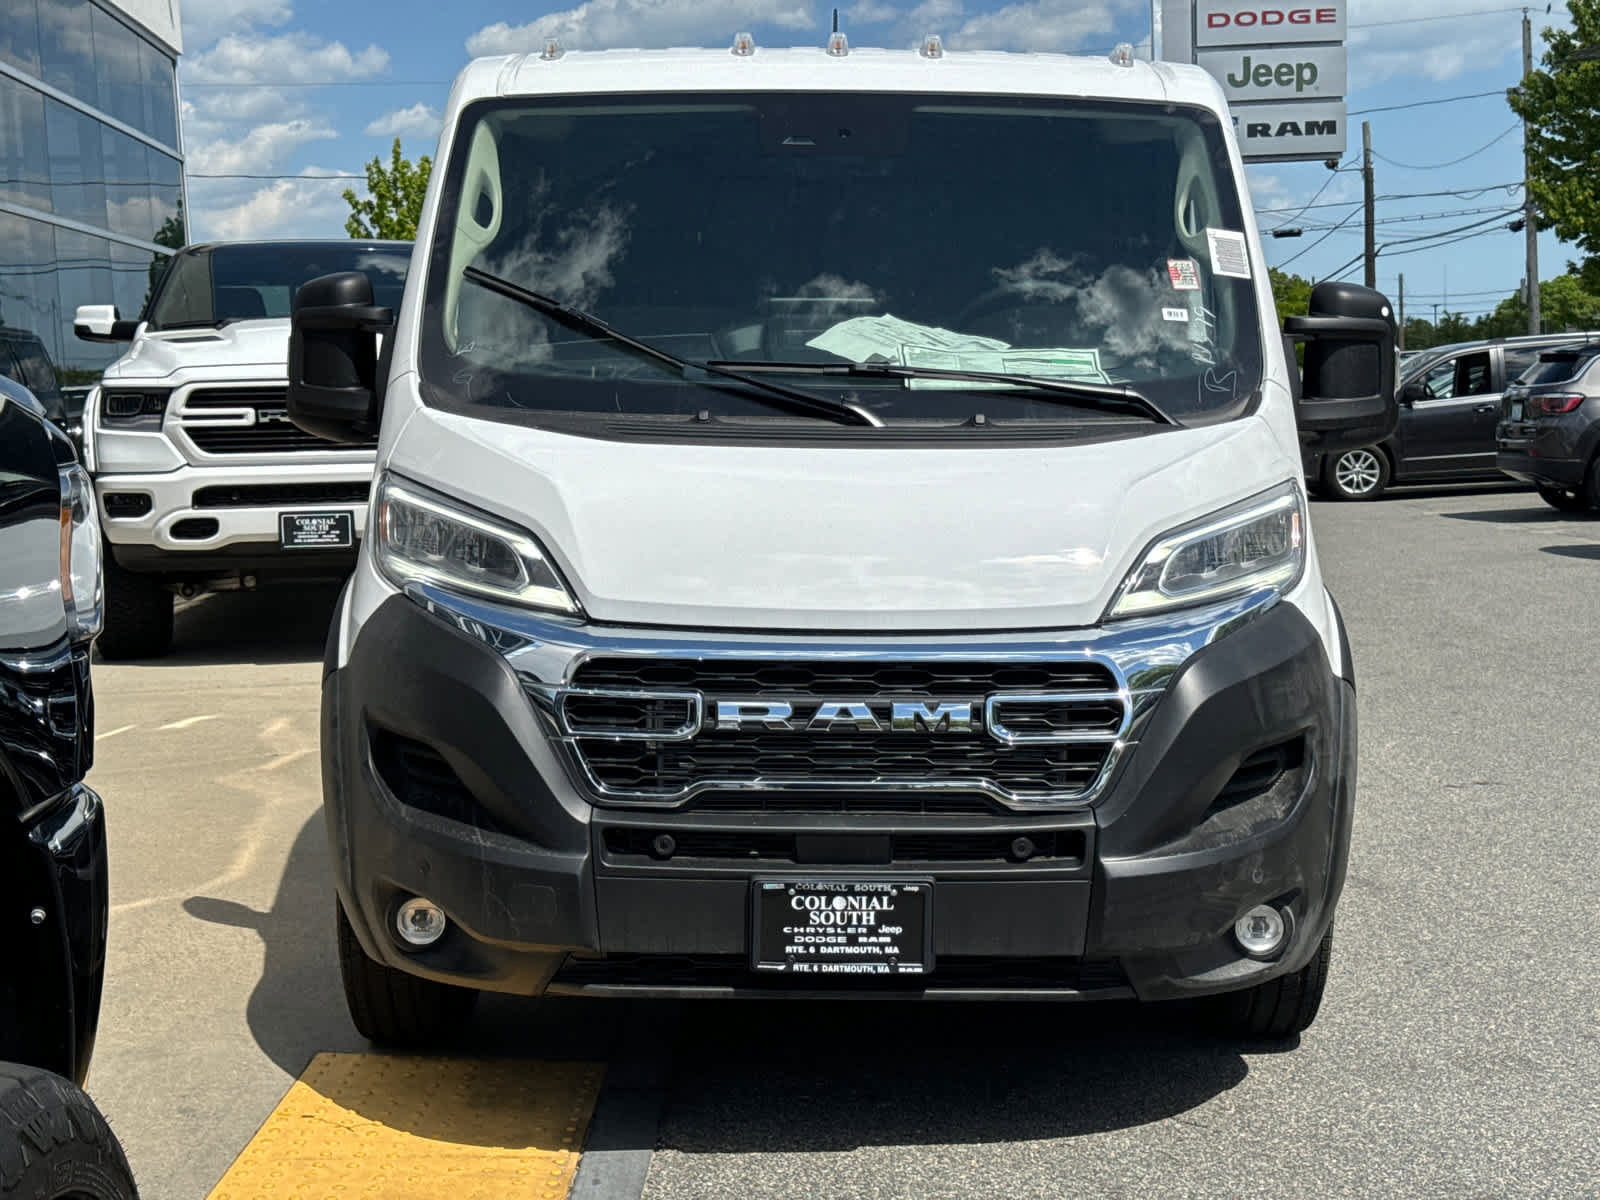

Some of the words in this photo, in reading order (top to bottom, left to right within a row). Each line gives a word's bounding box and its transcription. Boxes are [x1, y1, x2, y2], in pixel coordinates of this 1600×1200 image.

[1207, 8, 1337, 28] DODGE
[1227, 56, 1318, 92] Jeep
[1247, 120, 1337, 138] RAM
[716, 700, 972, 732] RAM
[795, 883, 848, 892] COLONIAL
[854, 883, 892, 892] SOUTH
[790, 895, 895, 911] COLONIAL
[809, 910, 876, 926] SOUTH
[782, 926, 868, 935] CHRYSLER
[877, 924, 903, 936] Jeep
[793, 935, 848, 943] DODGE
[785, 945, 808, 954] RTE.
[808, 945, 816, 954] 6
[819, 945, 883, 955] DARTMOUTH,
[884, 946, 900, 954] MA
[792, 963, 812, 972] RTE.
[812, 964, 818, 973] 6
[821, 964, 877, 974] DARTMOUTH,
[877, 965, 890, 973] MA
